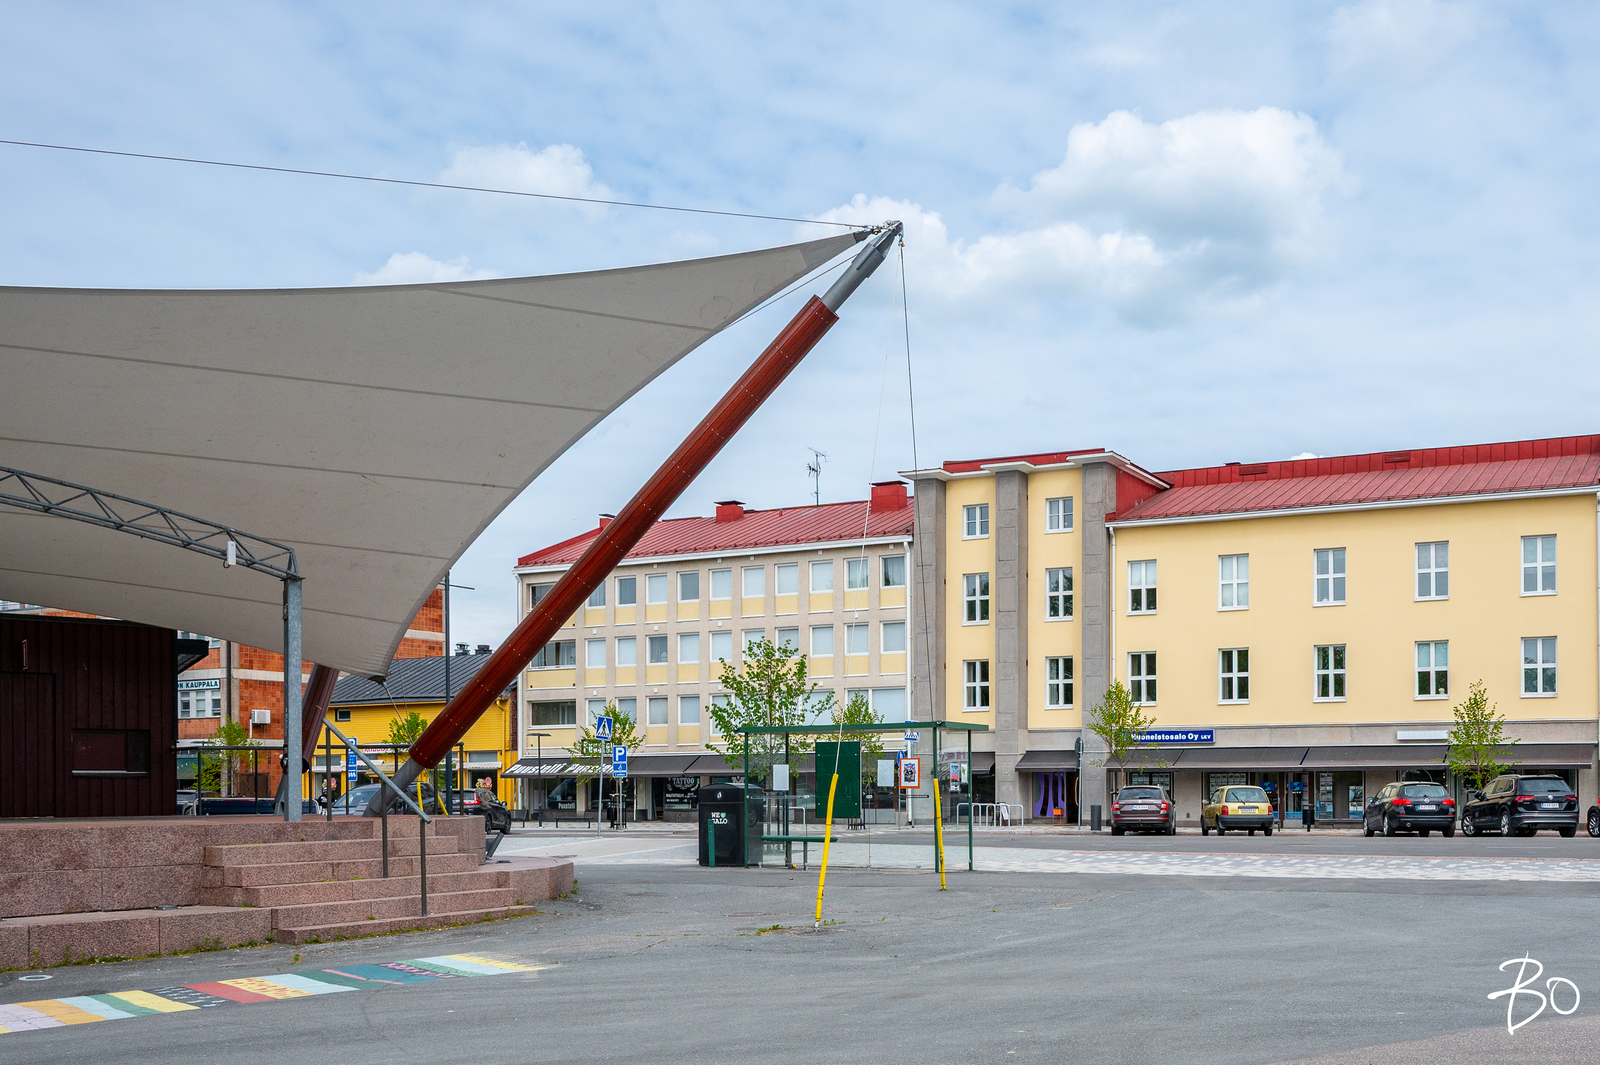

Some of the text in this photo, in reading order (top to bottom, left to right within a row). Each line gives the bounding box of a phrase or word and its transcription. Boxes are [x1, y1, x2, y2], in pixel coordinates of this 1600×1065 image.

[185, 681, 219, 689] KAUPPALA
[1187, 733, 1199, 741] Oy
[615, 747, 625, 762] P
[672, 777, 695, 785] TATTOO
